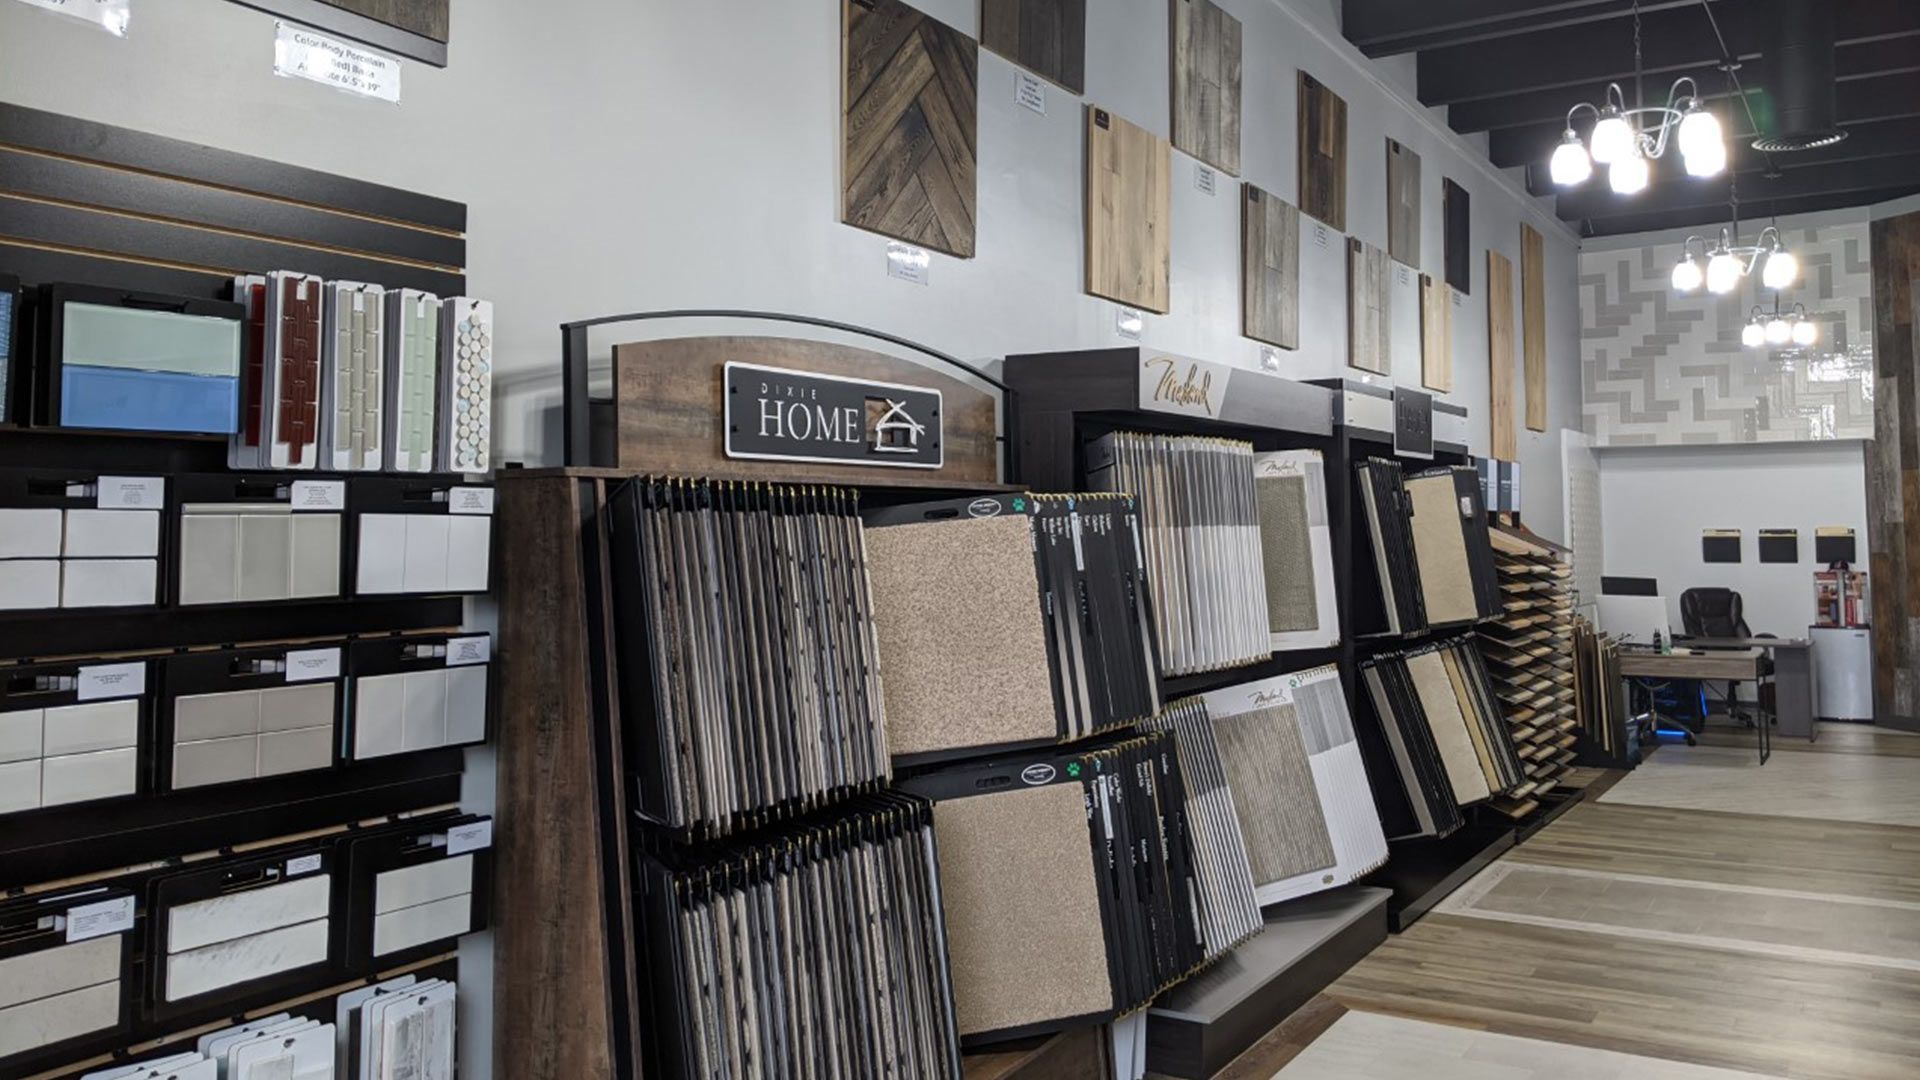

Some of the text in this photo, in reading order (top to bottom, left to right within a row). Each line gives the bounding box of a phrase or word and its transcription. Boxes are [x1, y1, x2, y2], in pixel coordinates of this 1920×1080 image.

[294, 34, 319, 48] Color
[761, 382, 817, 400] DIXIE
[758, 398, 861, 444] HOME
